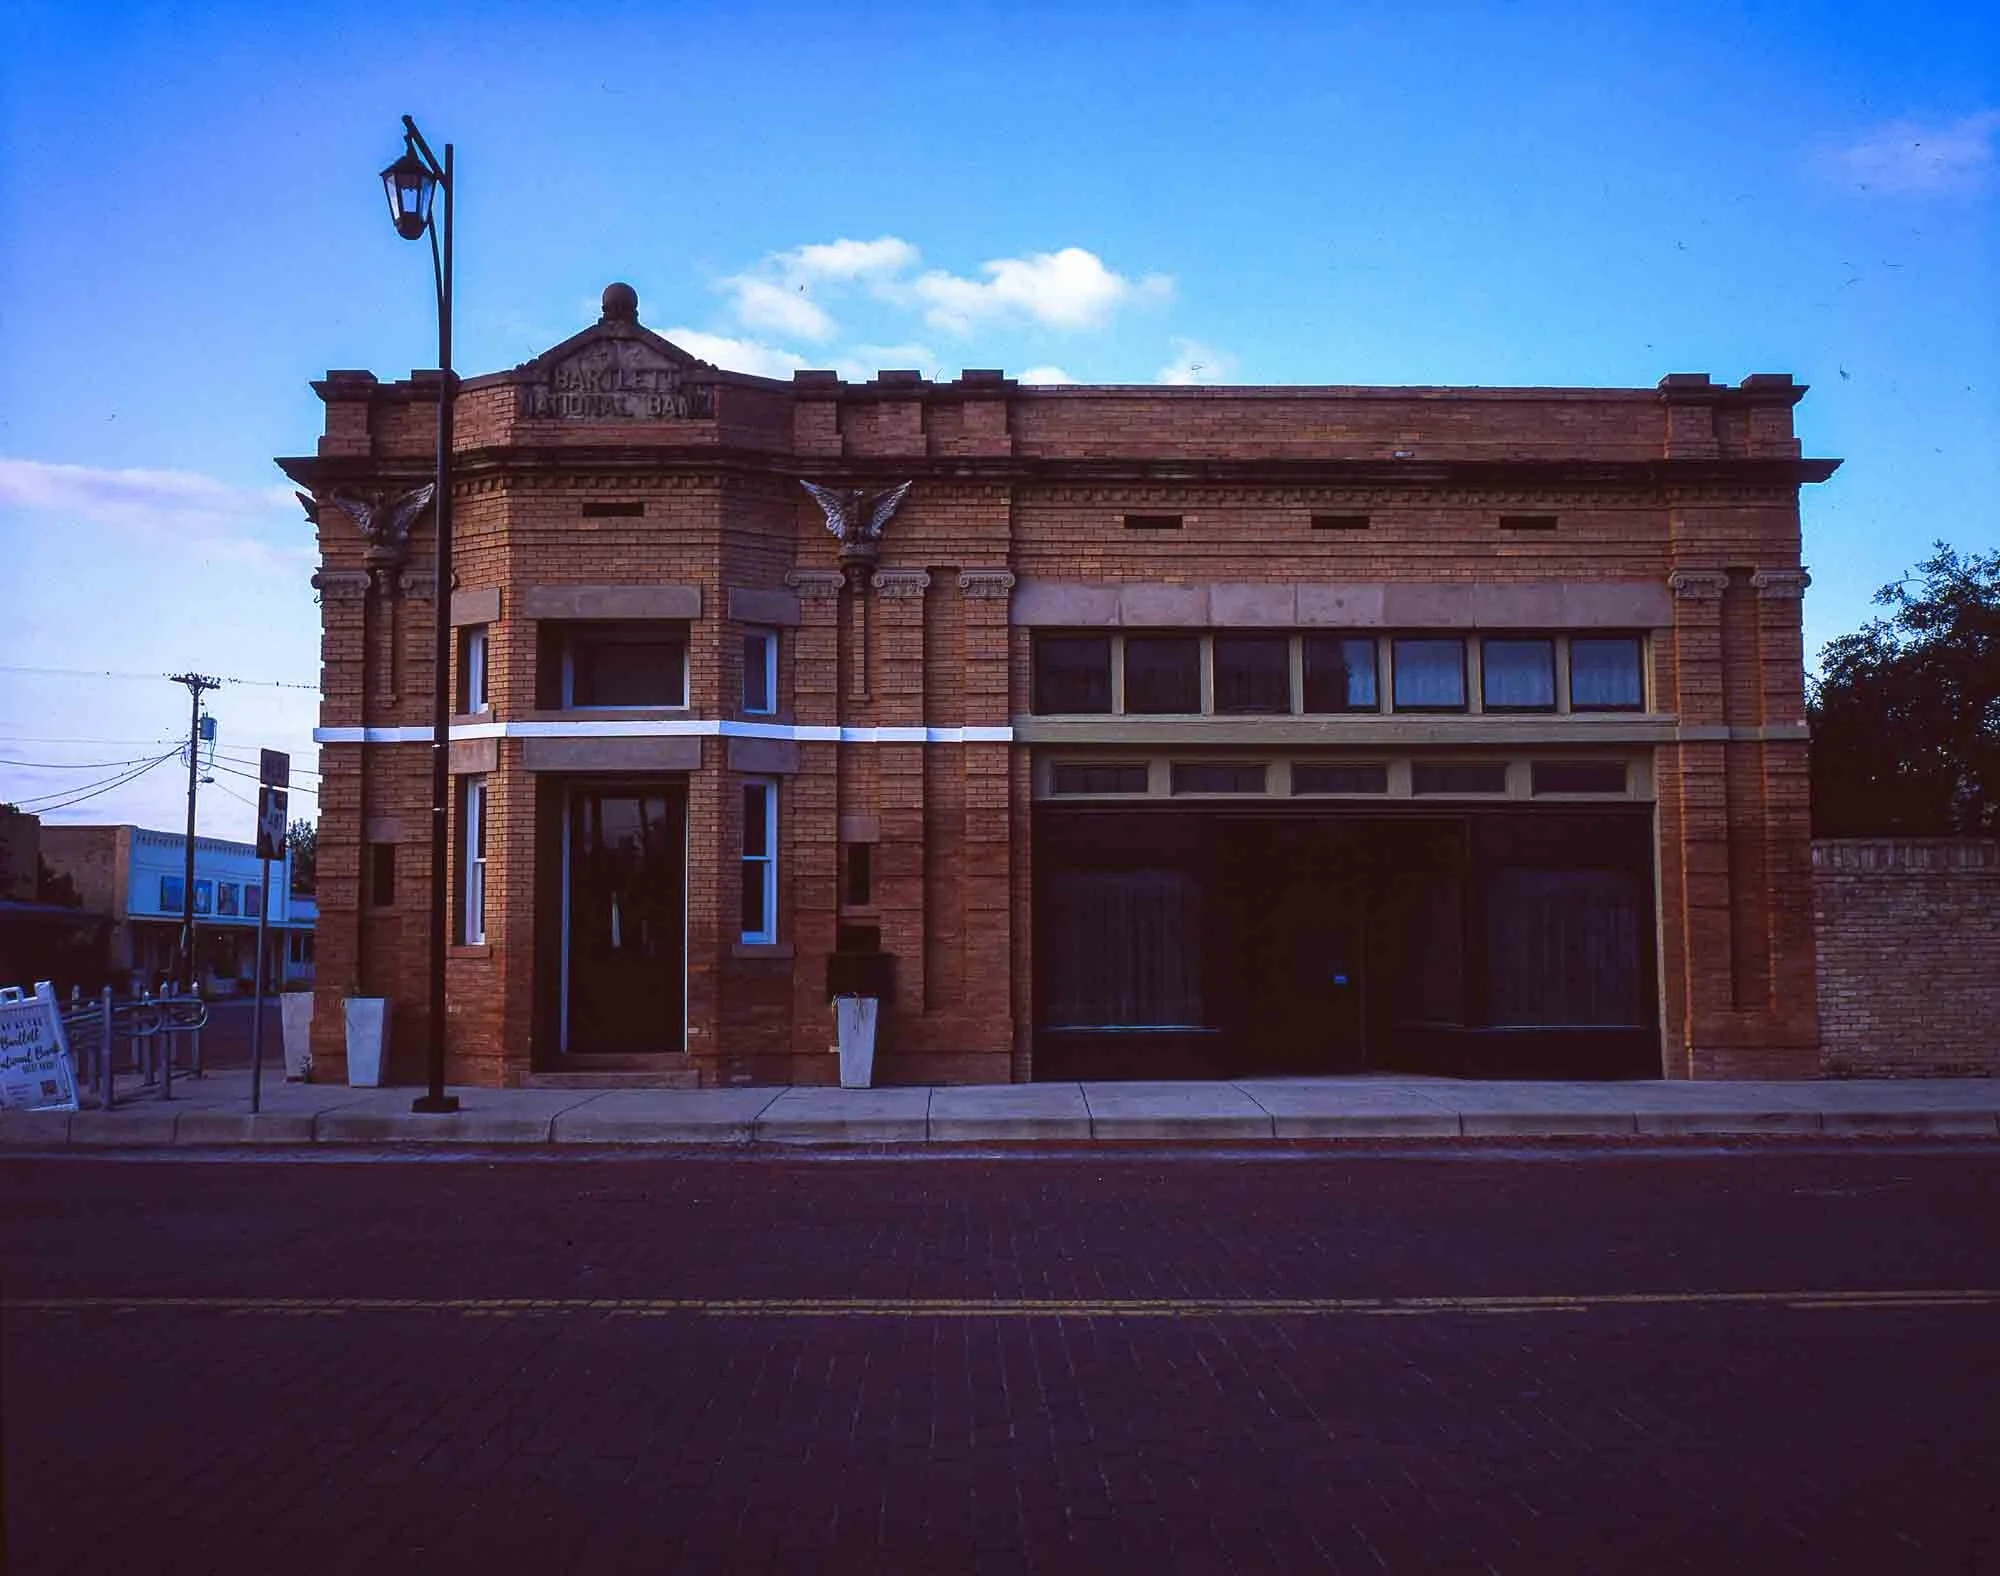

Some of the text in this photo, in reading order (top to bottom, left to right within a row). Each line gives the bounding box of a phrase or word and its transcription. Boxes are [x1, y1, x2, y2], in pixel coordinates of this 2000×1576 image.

[555, 368, 676, 391] BARTLETT
[525, 393, 712, 418] NATIONAL BANK
